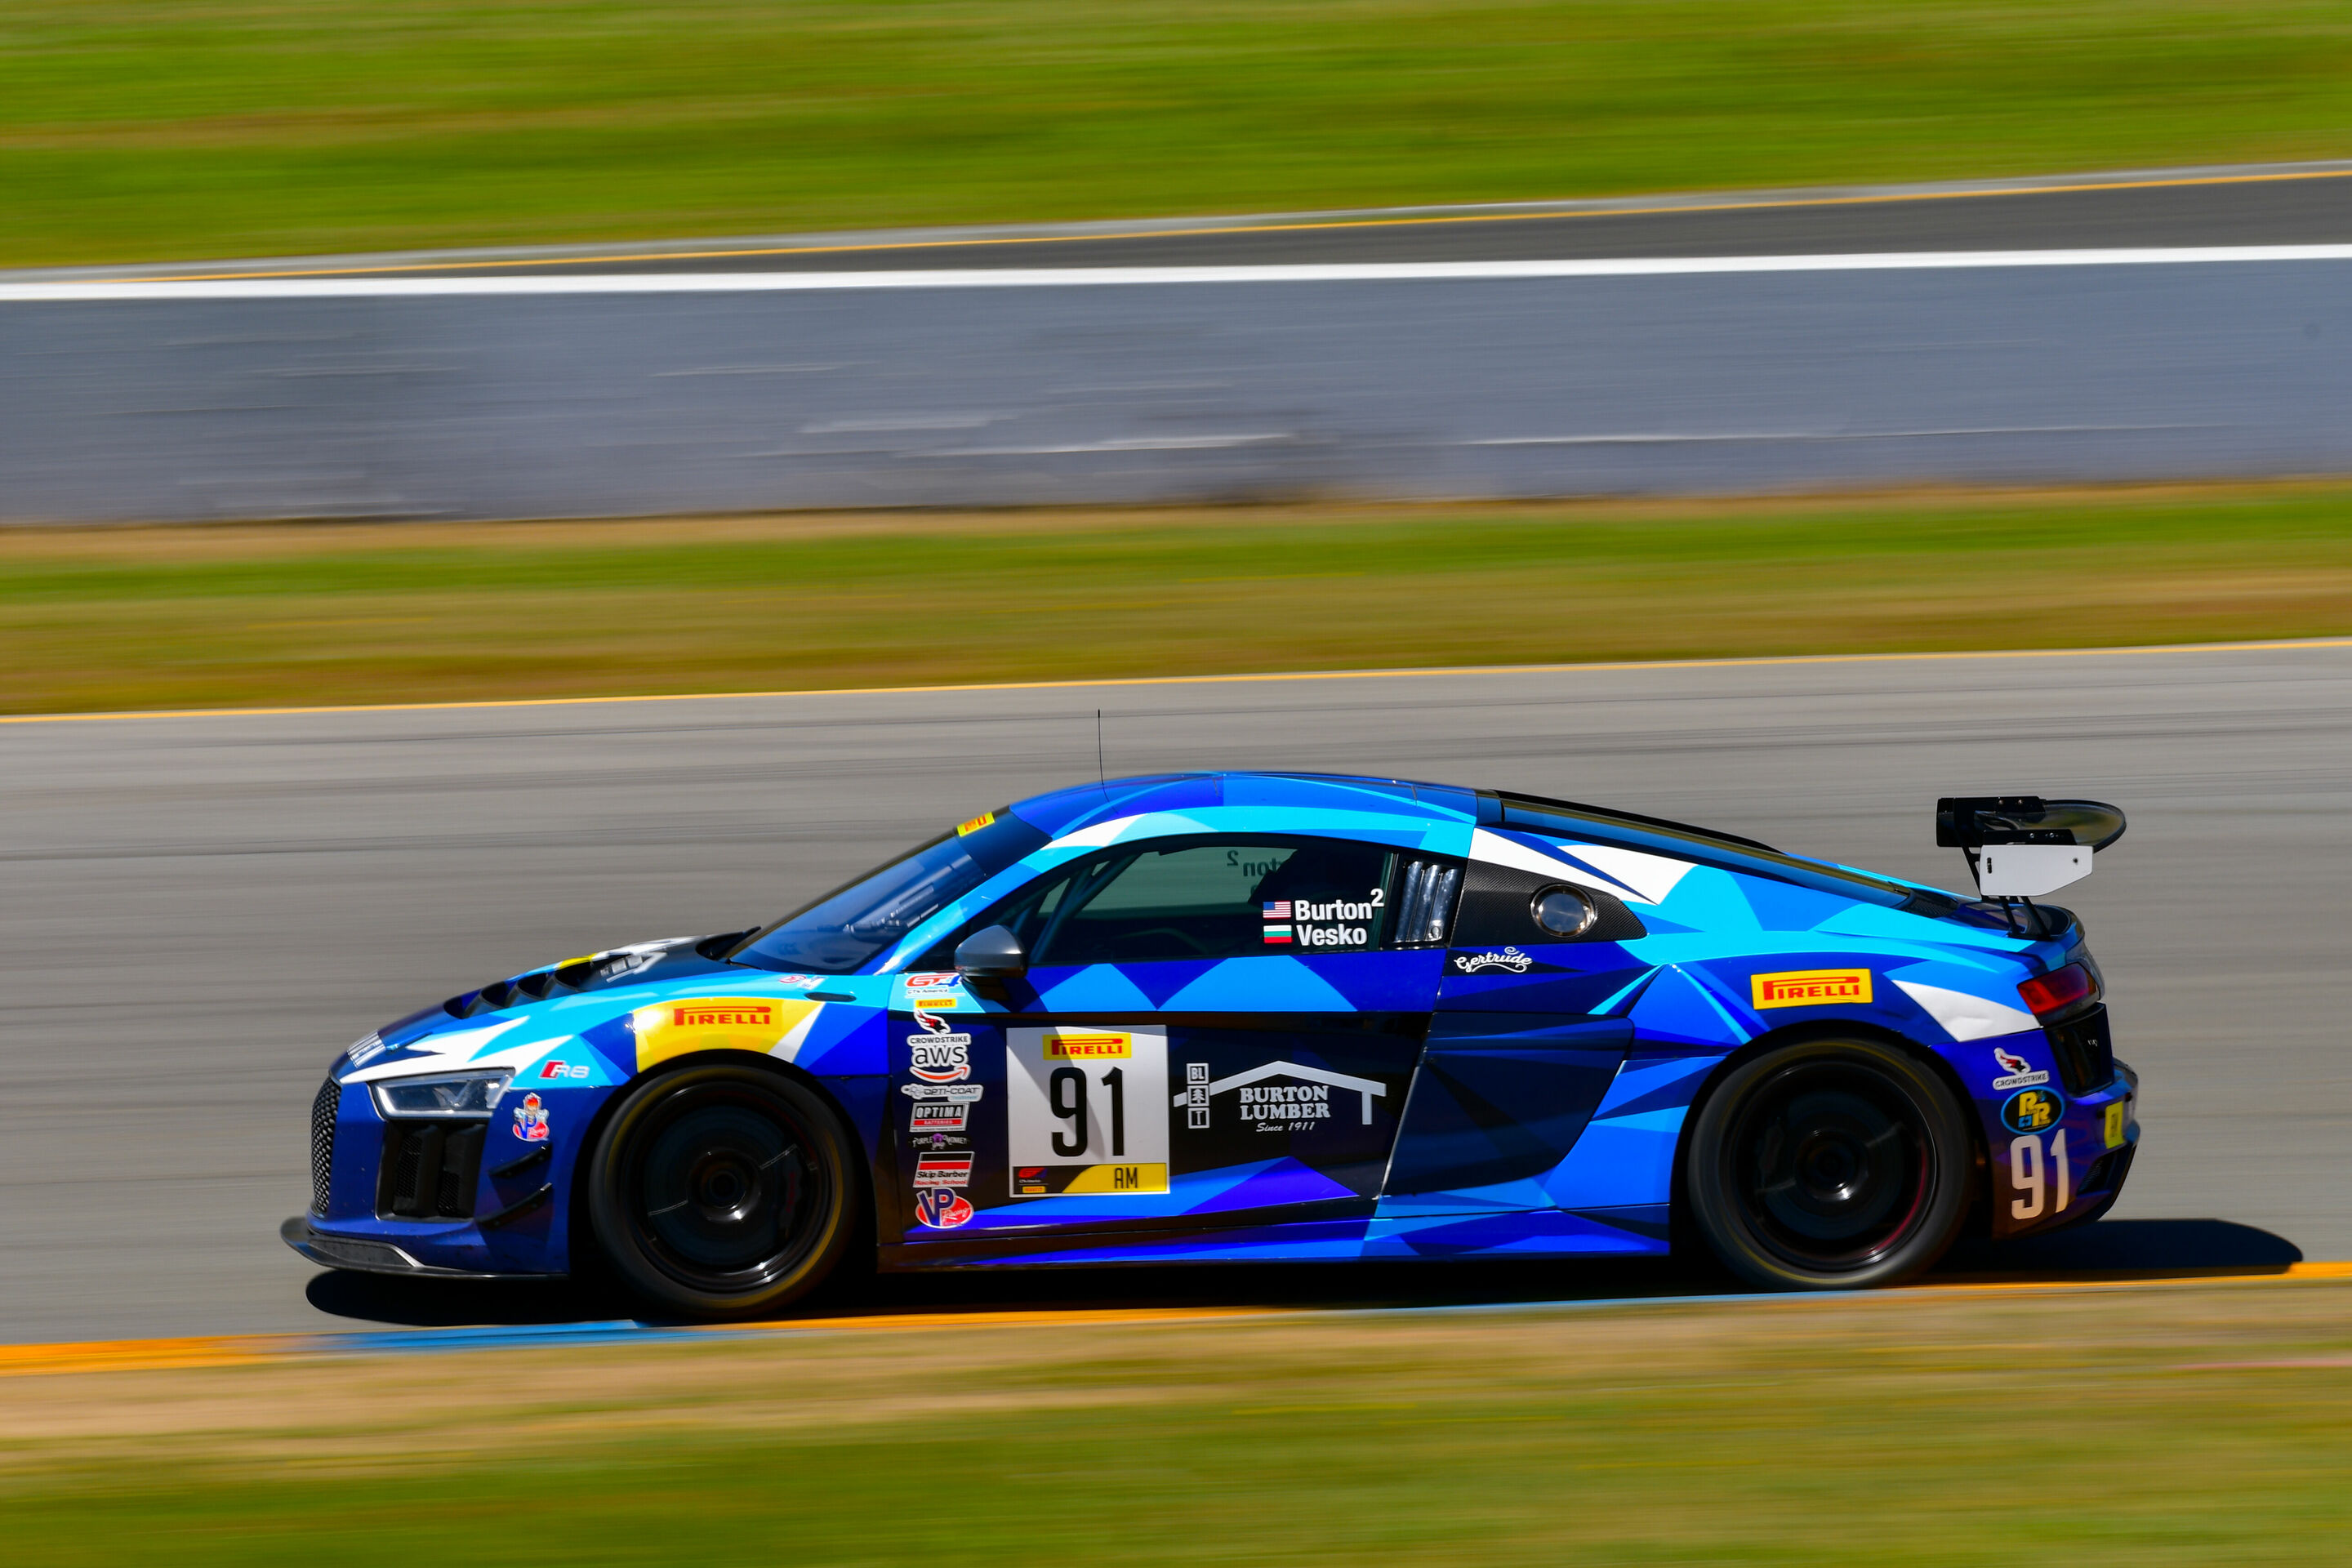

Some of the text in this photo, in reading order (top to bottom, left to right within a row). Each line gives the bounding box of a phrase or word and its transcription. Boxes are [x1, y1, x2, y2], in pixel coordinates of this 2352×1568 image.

[1296, 924, 1367, 947] Vesko
[1454, 947, 1533, 973] Gertrude
[906, 973, 962, 987] GT4
[1762, 977, 1860, 1000] PIRELLI
[673, 1006, 772, 1026] PIRELLI
[910, 1036, 968, 1044] CROWDSTRIKE
[1051, 1038, 1124, 1055] PIRELLI
[915, 1046, 964, 1065] aws
[539, 1061, 590, 1079] R8
[1191, 1067, 1205, 1080] BL
[1994, 1072, 2048, 1087] CROWDSTRIKE
[923, 1087, 981, 1095] OPTI-COAT
[1239, 1085, 1330, 1104] BURTON
[915, 1106, 962, 1118] OPTIMA
[1049, 1066, 1125, 1157] 91
[1240, 1102, 1331, 1120] LUMBER
[1256, 1121, 1316, 1133] Since 1911
[1114, 1167, 1138, 1189] AM
[2010, 1128, 2070, 1220] 91
[917, 1187, 955, 1227] VP
